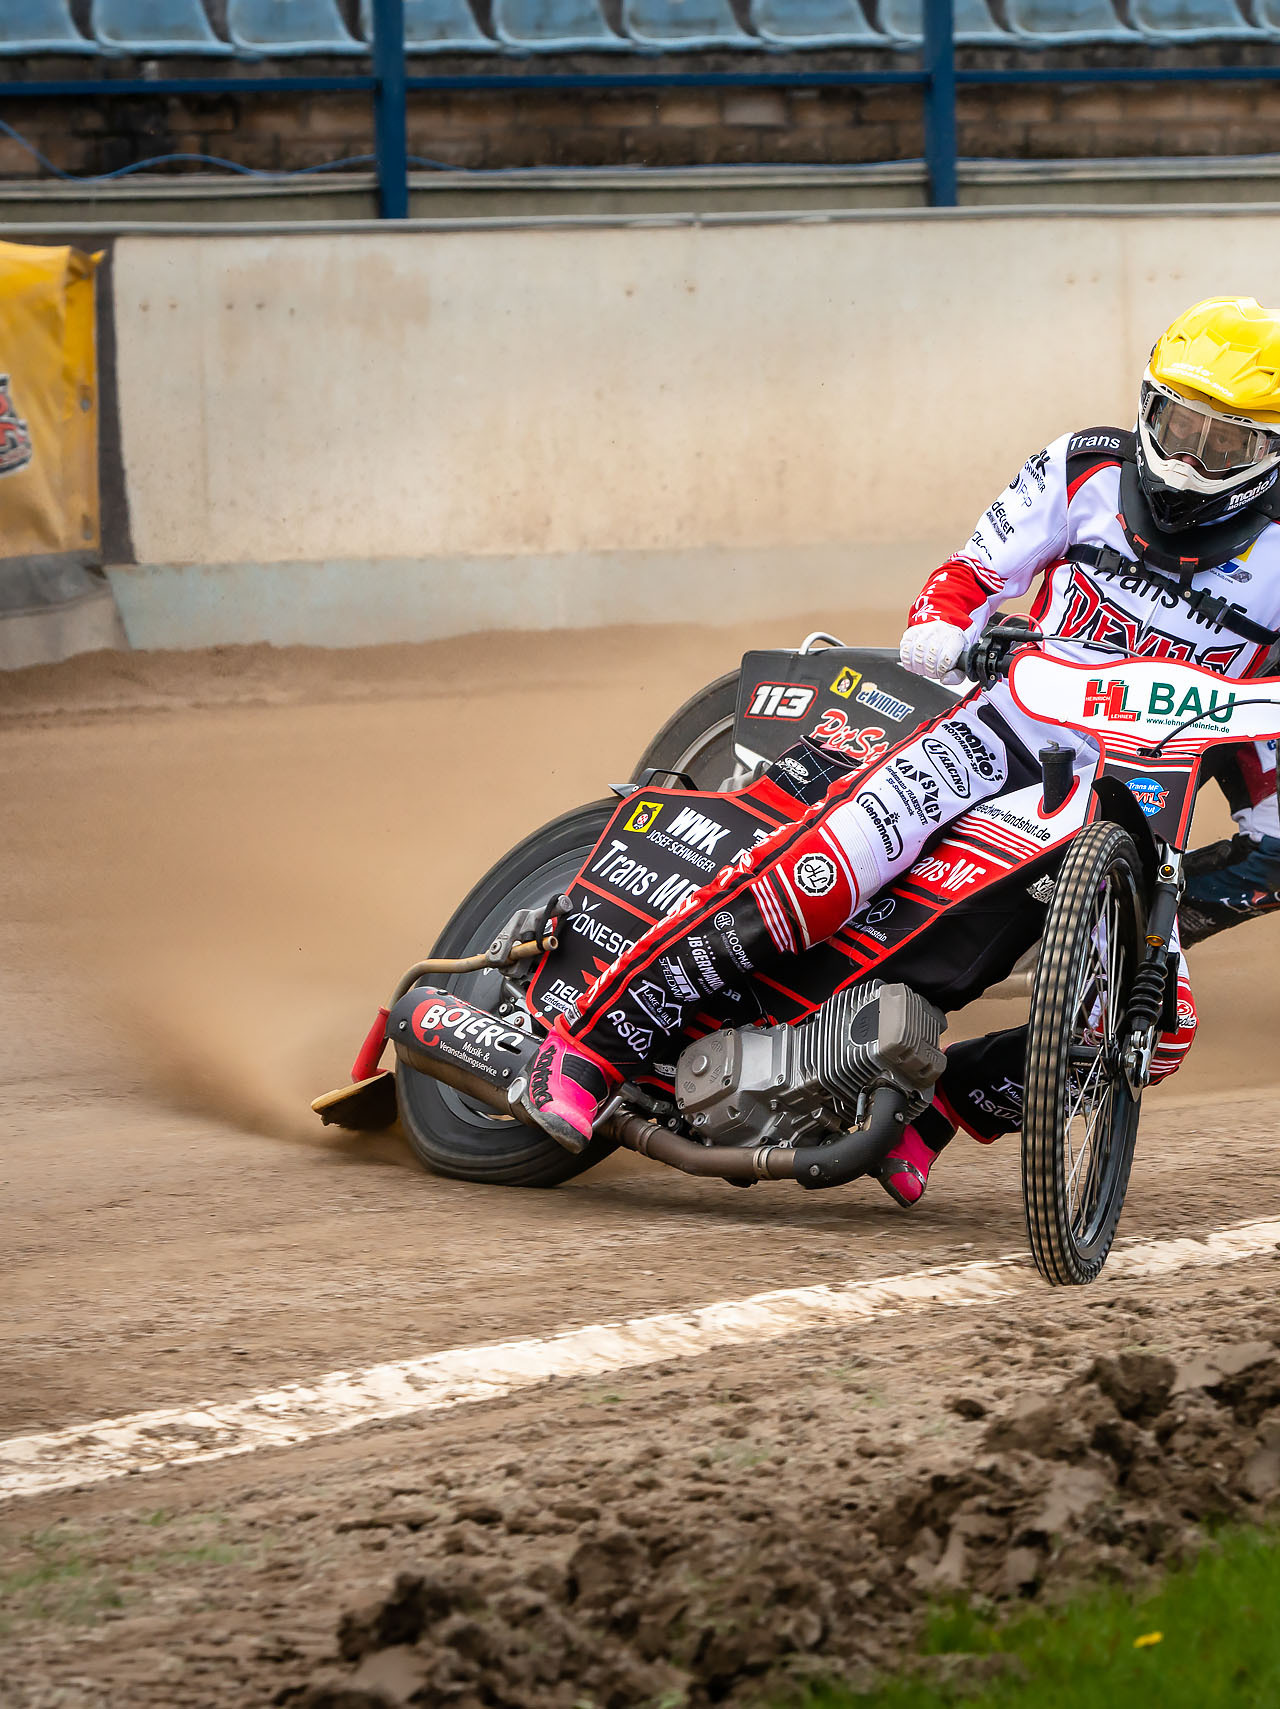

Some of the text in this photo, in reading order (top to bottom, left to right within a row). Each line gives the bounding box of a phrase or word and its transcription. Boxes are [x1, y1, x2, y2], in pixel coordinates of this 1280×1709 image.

[1070, 434, 1121, 450] Trans
[749, 685, 815, 718] 113
[1147, 682, 1236, 723] BAU
[665, 806, 732, 856] WWK
[861, 798, 894, 856] Lienemann
[591, 839, 659, 897] Trans
[646, 829, 673, 848] JOSEF
[667, 841, 717, 873] SCHWAIGER
[942, 858, 987, 892] MF
[420, 1003, 525, 1053] BOLERO
[438, 1040, 498, 1077] Veranstaltungsservice
